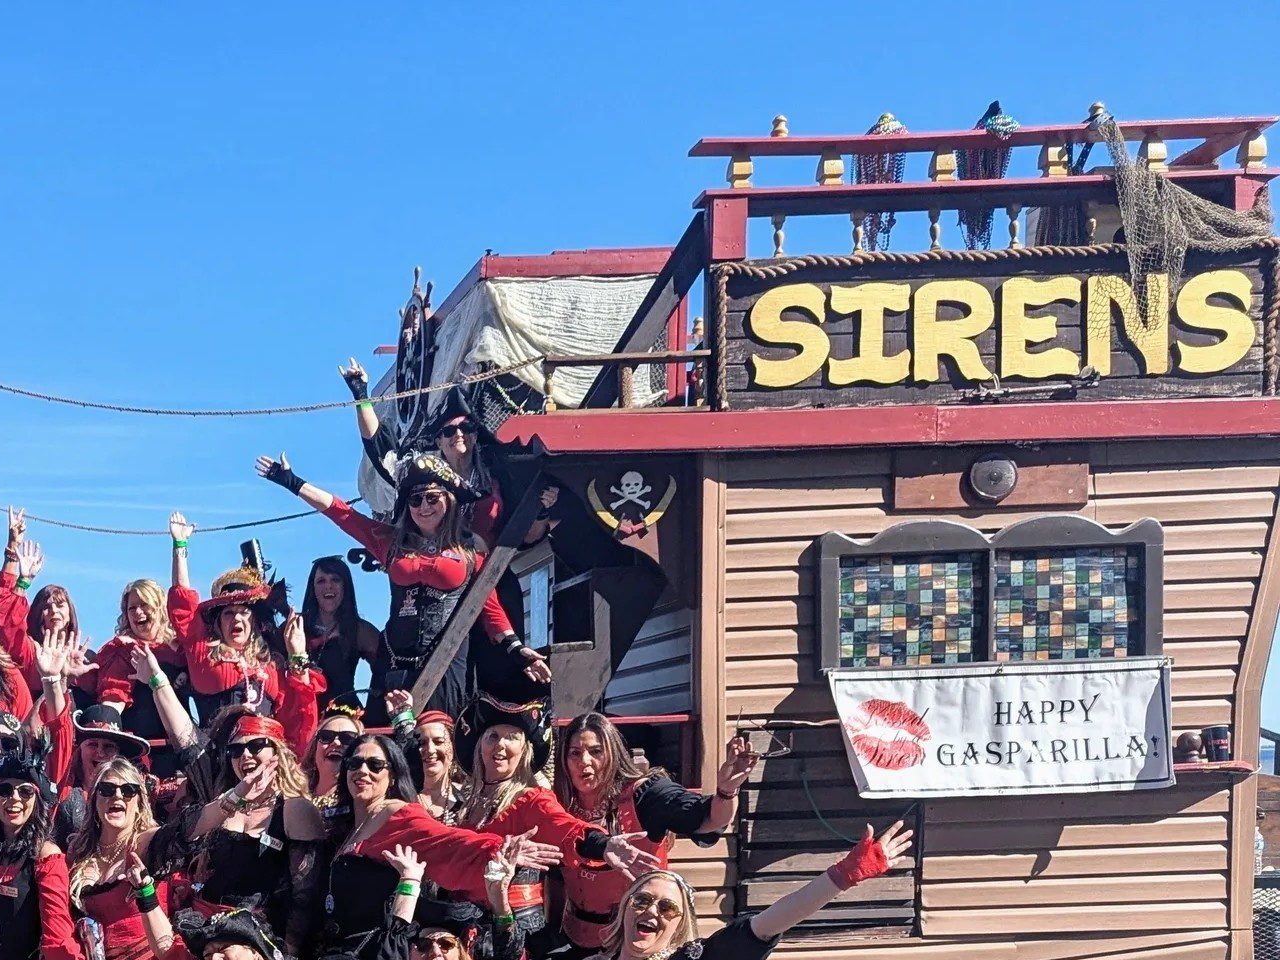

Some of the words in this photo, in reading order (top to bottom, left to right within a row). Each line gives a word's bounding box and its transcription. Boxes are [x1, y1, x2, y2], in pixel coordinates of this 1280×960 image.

[751, 270, 1256, 388] SIRENS
[994, 693, 1102, 726] HAPPY
[936, 734, 1161, 766] GASPARILLA!
